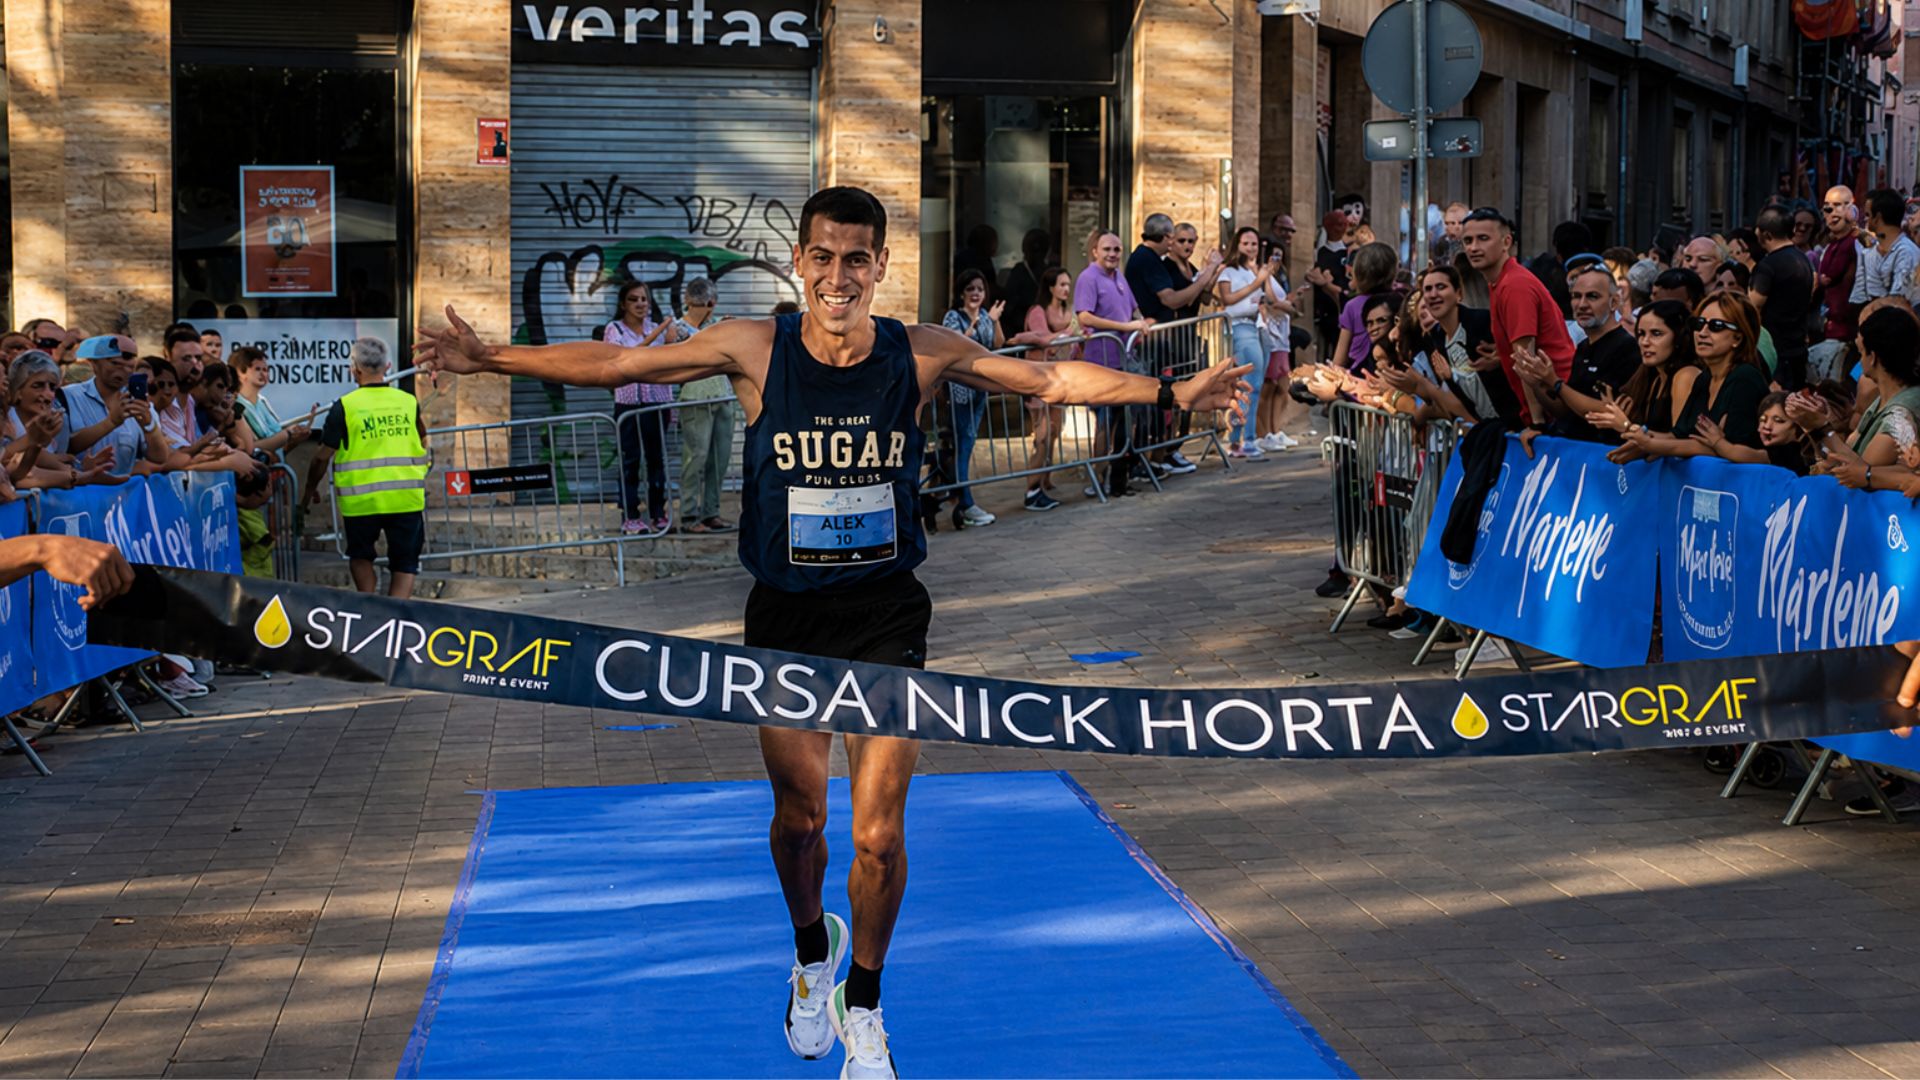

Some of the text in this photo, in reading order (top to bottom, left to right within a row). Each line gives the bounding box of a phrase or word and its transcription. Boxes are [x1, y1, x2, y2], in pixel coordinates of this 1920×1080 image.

[522, 0, 810, 48] veritas
[814, 415, 872, 426] THE GREAT
[773, 431, 906, 471] SUGAR
[820, 515, 866, 531] ALEX
[835, 533, 853, 546] 10
[303, 606, 1757, 752] STARGRAF CURSA NICK HORTA STARGRAF
[463, 673, 497, 686] PRINT
[509, 678, 550, 691] EVENT
[1705, 723, 1746, 736] EVENT
